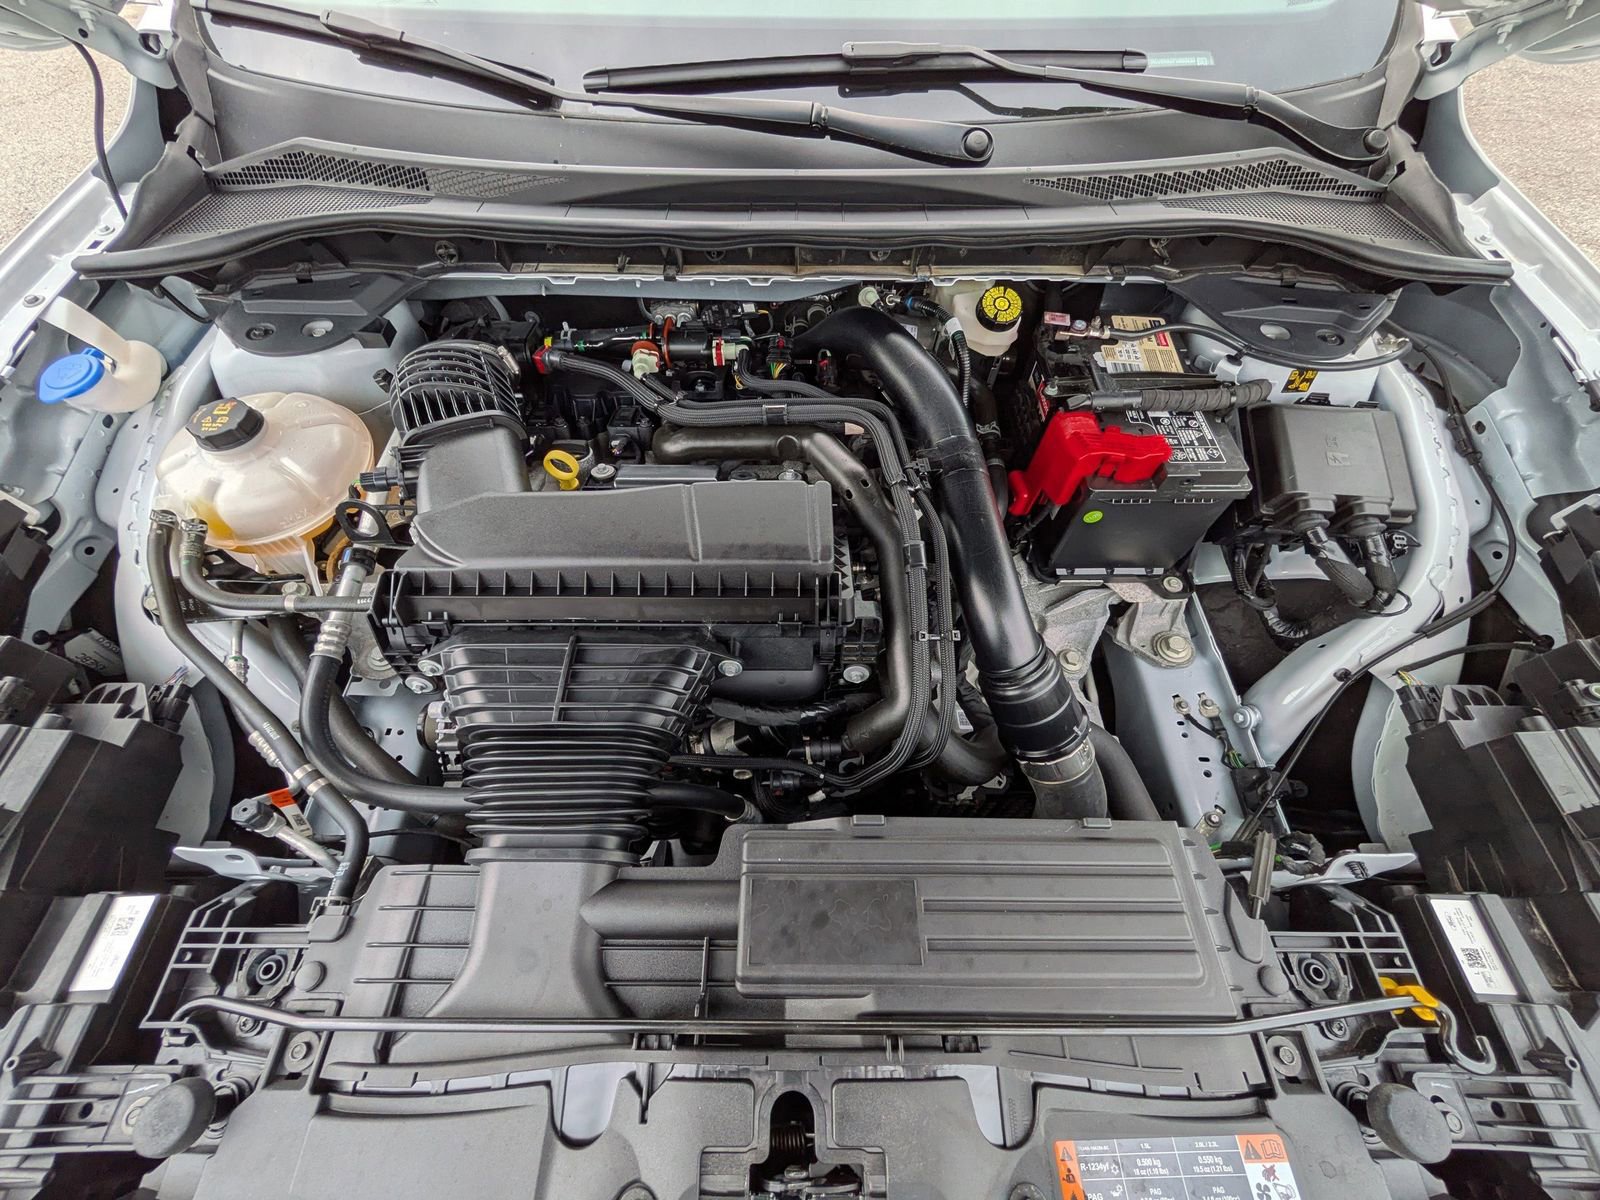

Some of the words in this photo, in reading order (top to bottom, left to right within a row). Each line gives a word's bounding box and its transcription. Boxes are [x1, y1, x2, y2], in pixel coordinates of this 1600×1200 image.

[1136, 1158, 1152, 1167] 0.500
[1152, 1157, 1161, 1168] kg
[1197, 1155, 1214, 1164] 0.550
[1214, 1155, 1223, 1165] kg
[1080, 1162, 1109, 1173] R-1234yf
[1149, 1187, 1162, 1196] PAG
[1212, 1186, 1225, 1194] PAG
[1087, 1192, 1104, 1200] PAG
